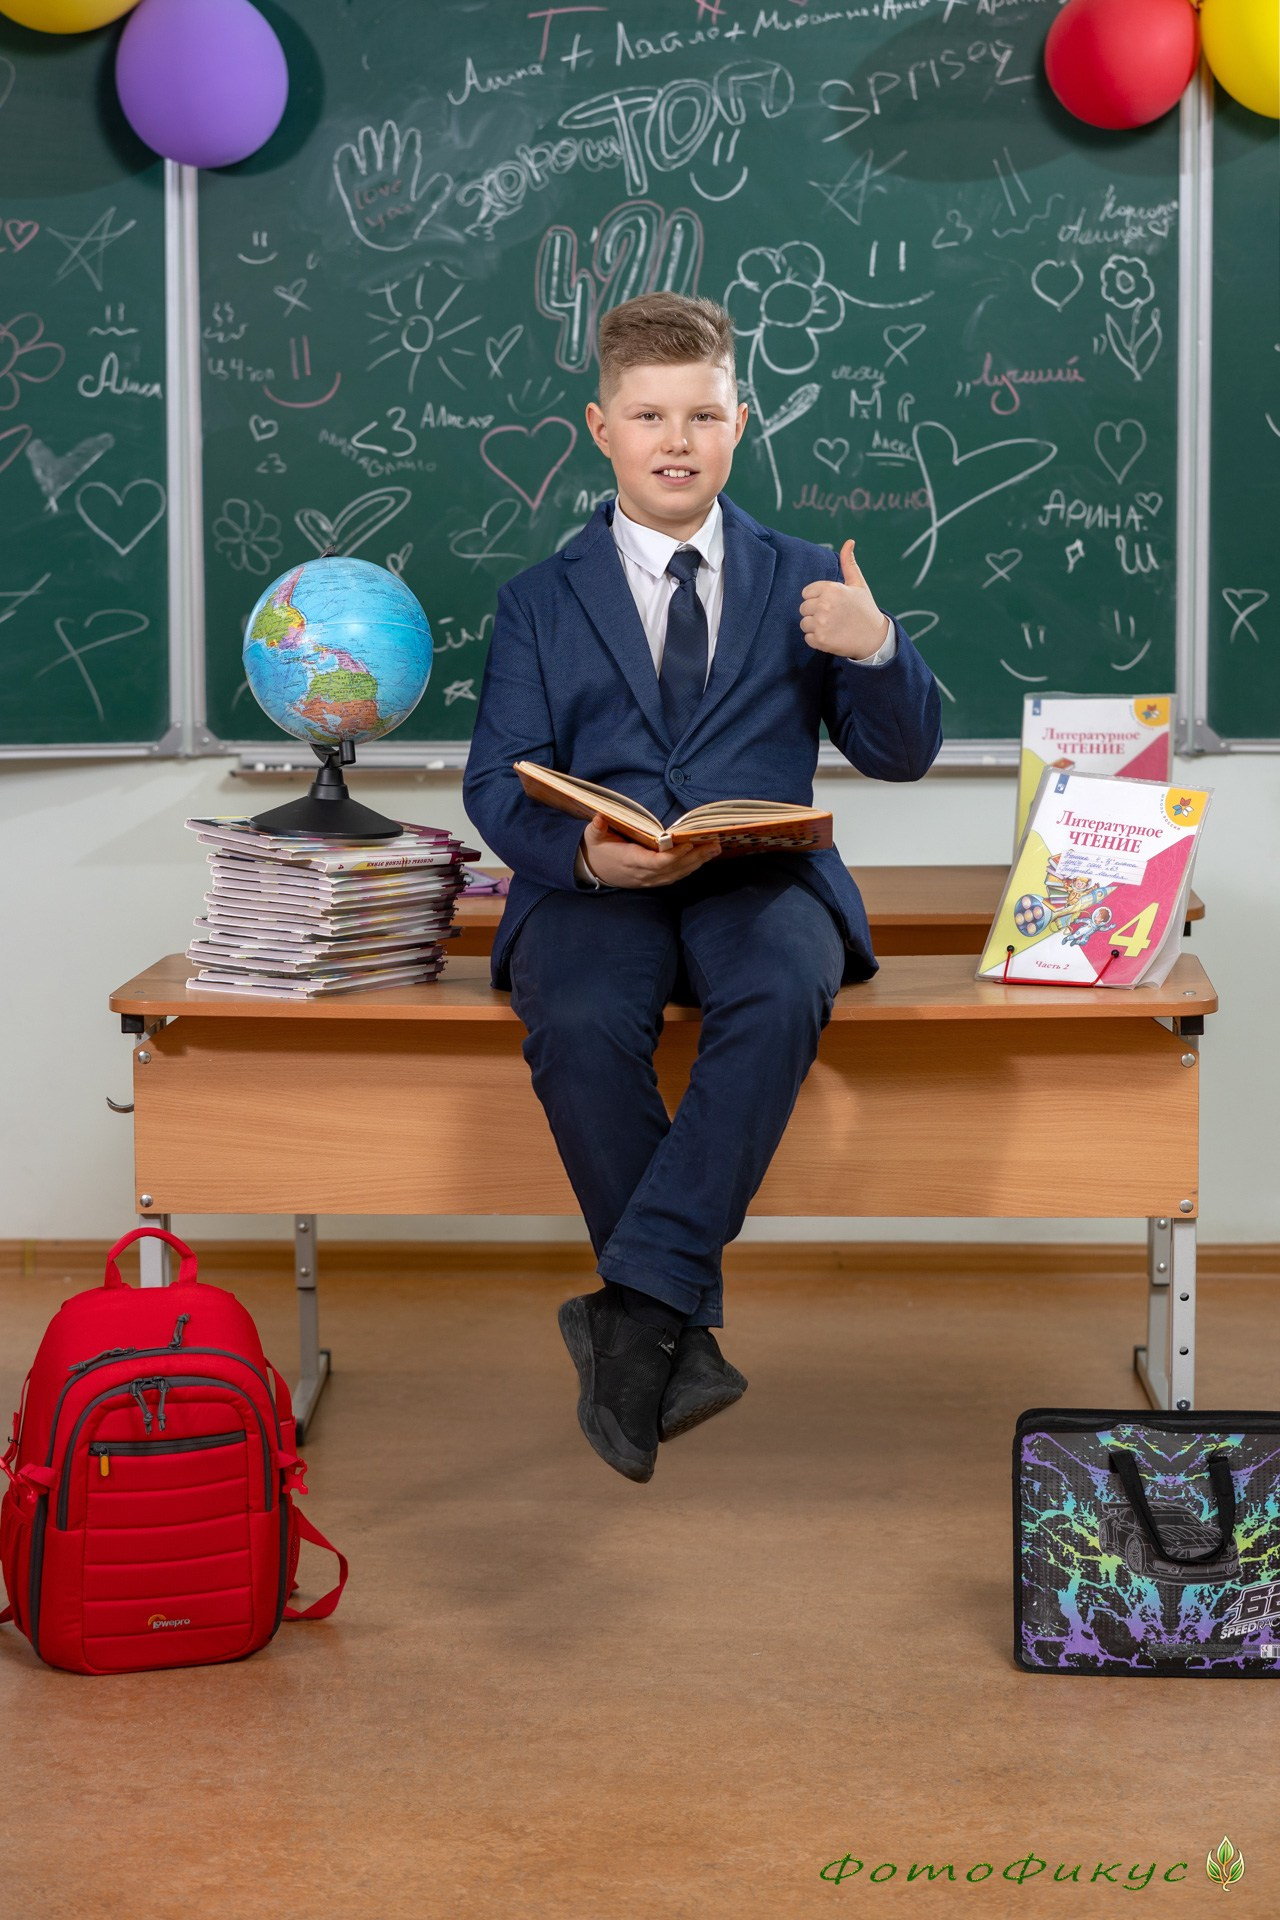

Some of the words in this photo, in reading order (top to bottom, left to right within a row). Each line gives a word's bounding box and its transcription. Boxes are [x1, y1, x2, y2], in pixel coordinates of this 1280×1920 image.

[1041, 727, 1141, 743] Литературное
[1057, 742, 1126, 755] ЧТЕНИЕ
[1056, 809, 1164, 839] Литературное
[1069, 830, 1143, 854] ЧТЕНИЕ
[1108, 902, 1160, 958] 4
[1035, 960, 1061, 970] Часть
